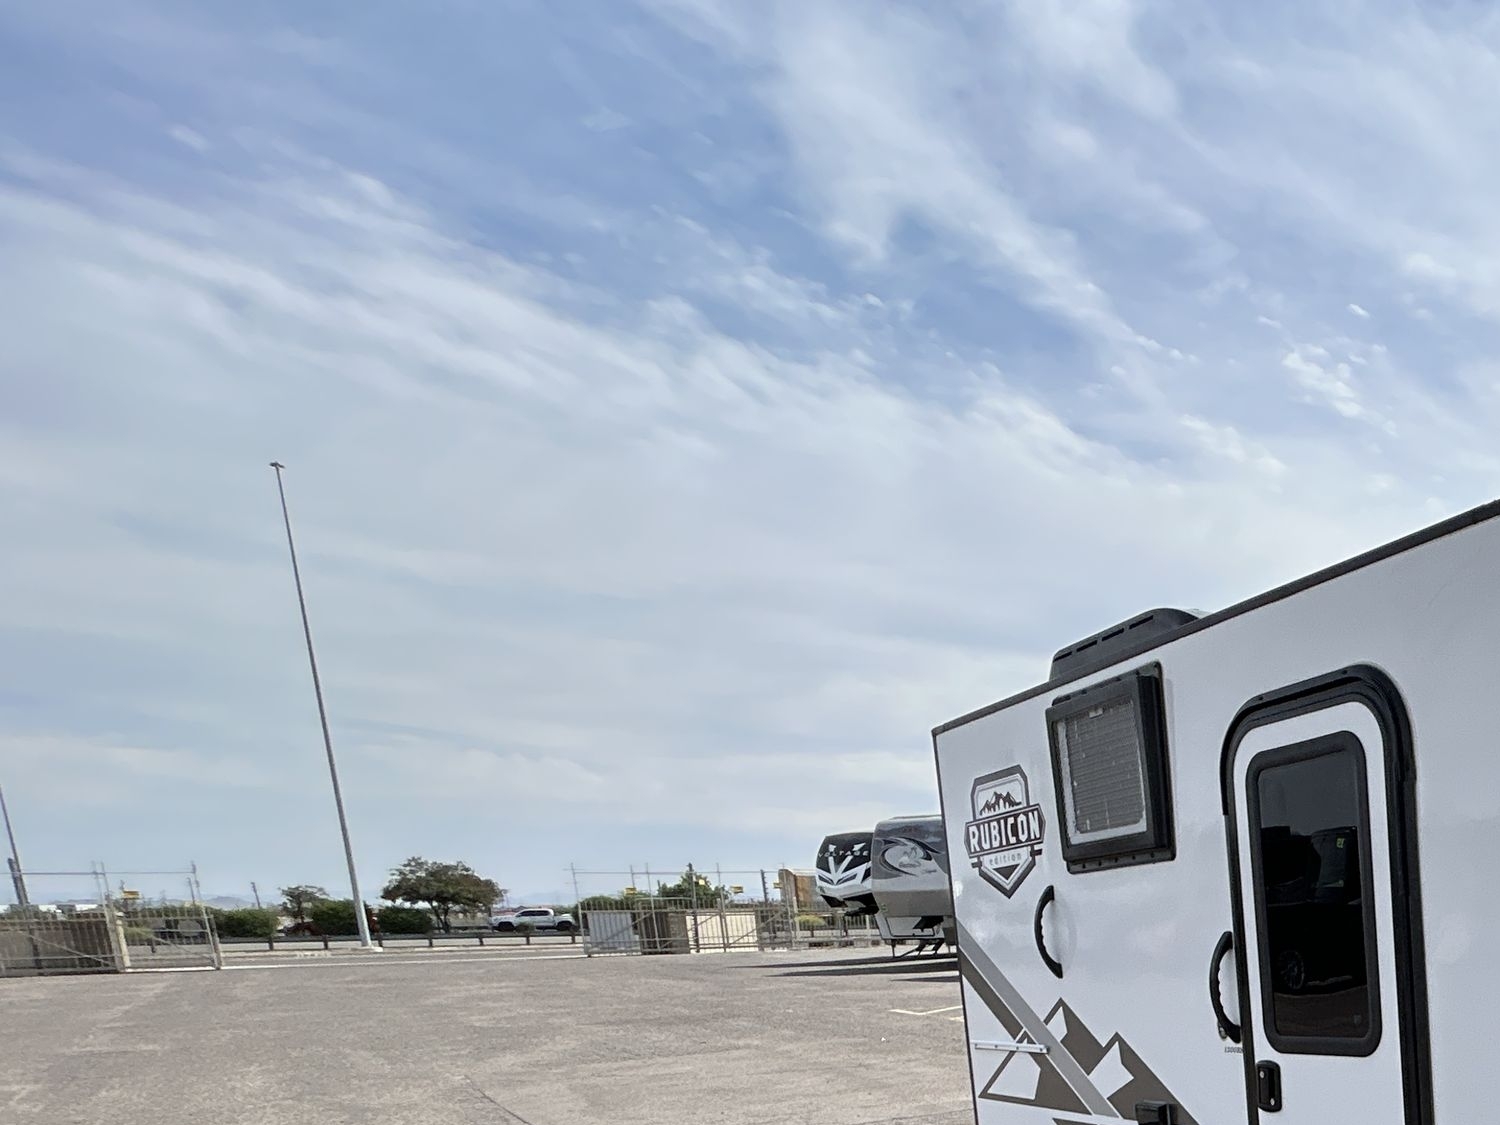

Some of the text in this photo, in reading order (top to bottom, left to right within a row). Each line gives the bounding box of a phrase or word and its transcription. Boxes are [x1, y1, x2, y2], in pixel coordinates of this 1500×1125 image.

[968, 811, 1040, 853] RUBICON
[818, 850, 869, 858] VOLTAGE
[989, 852, 1022, 866] edition
